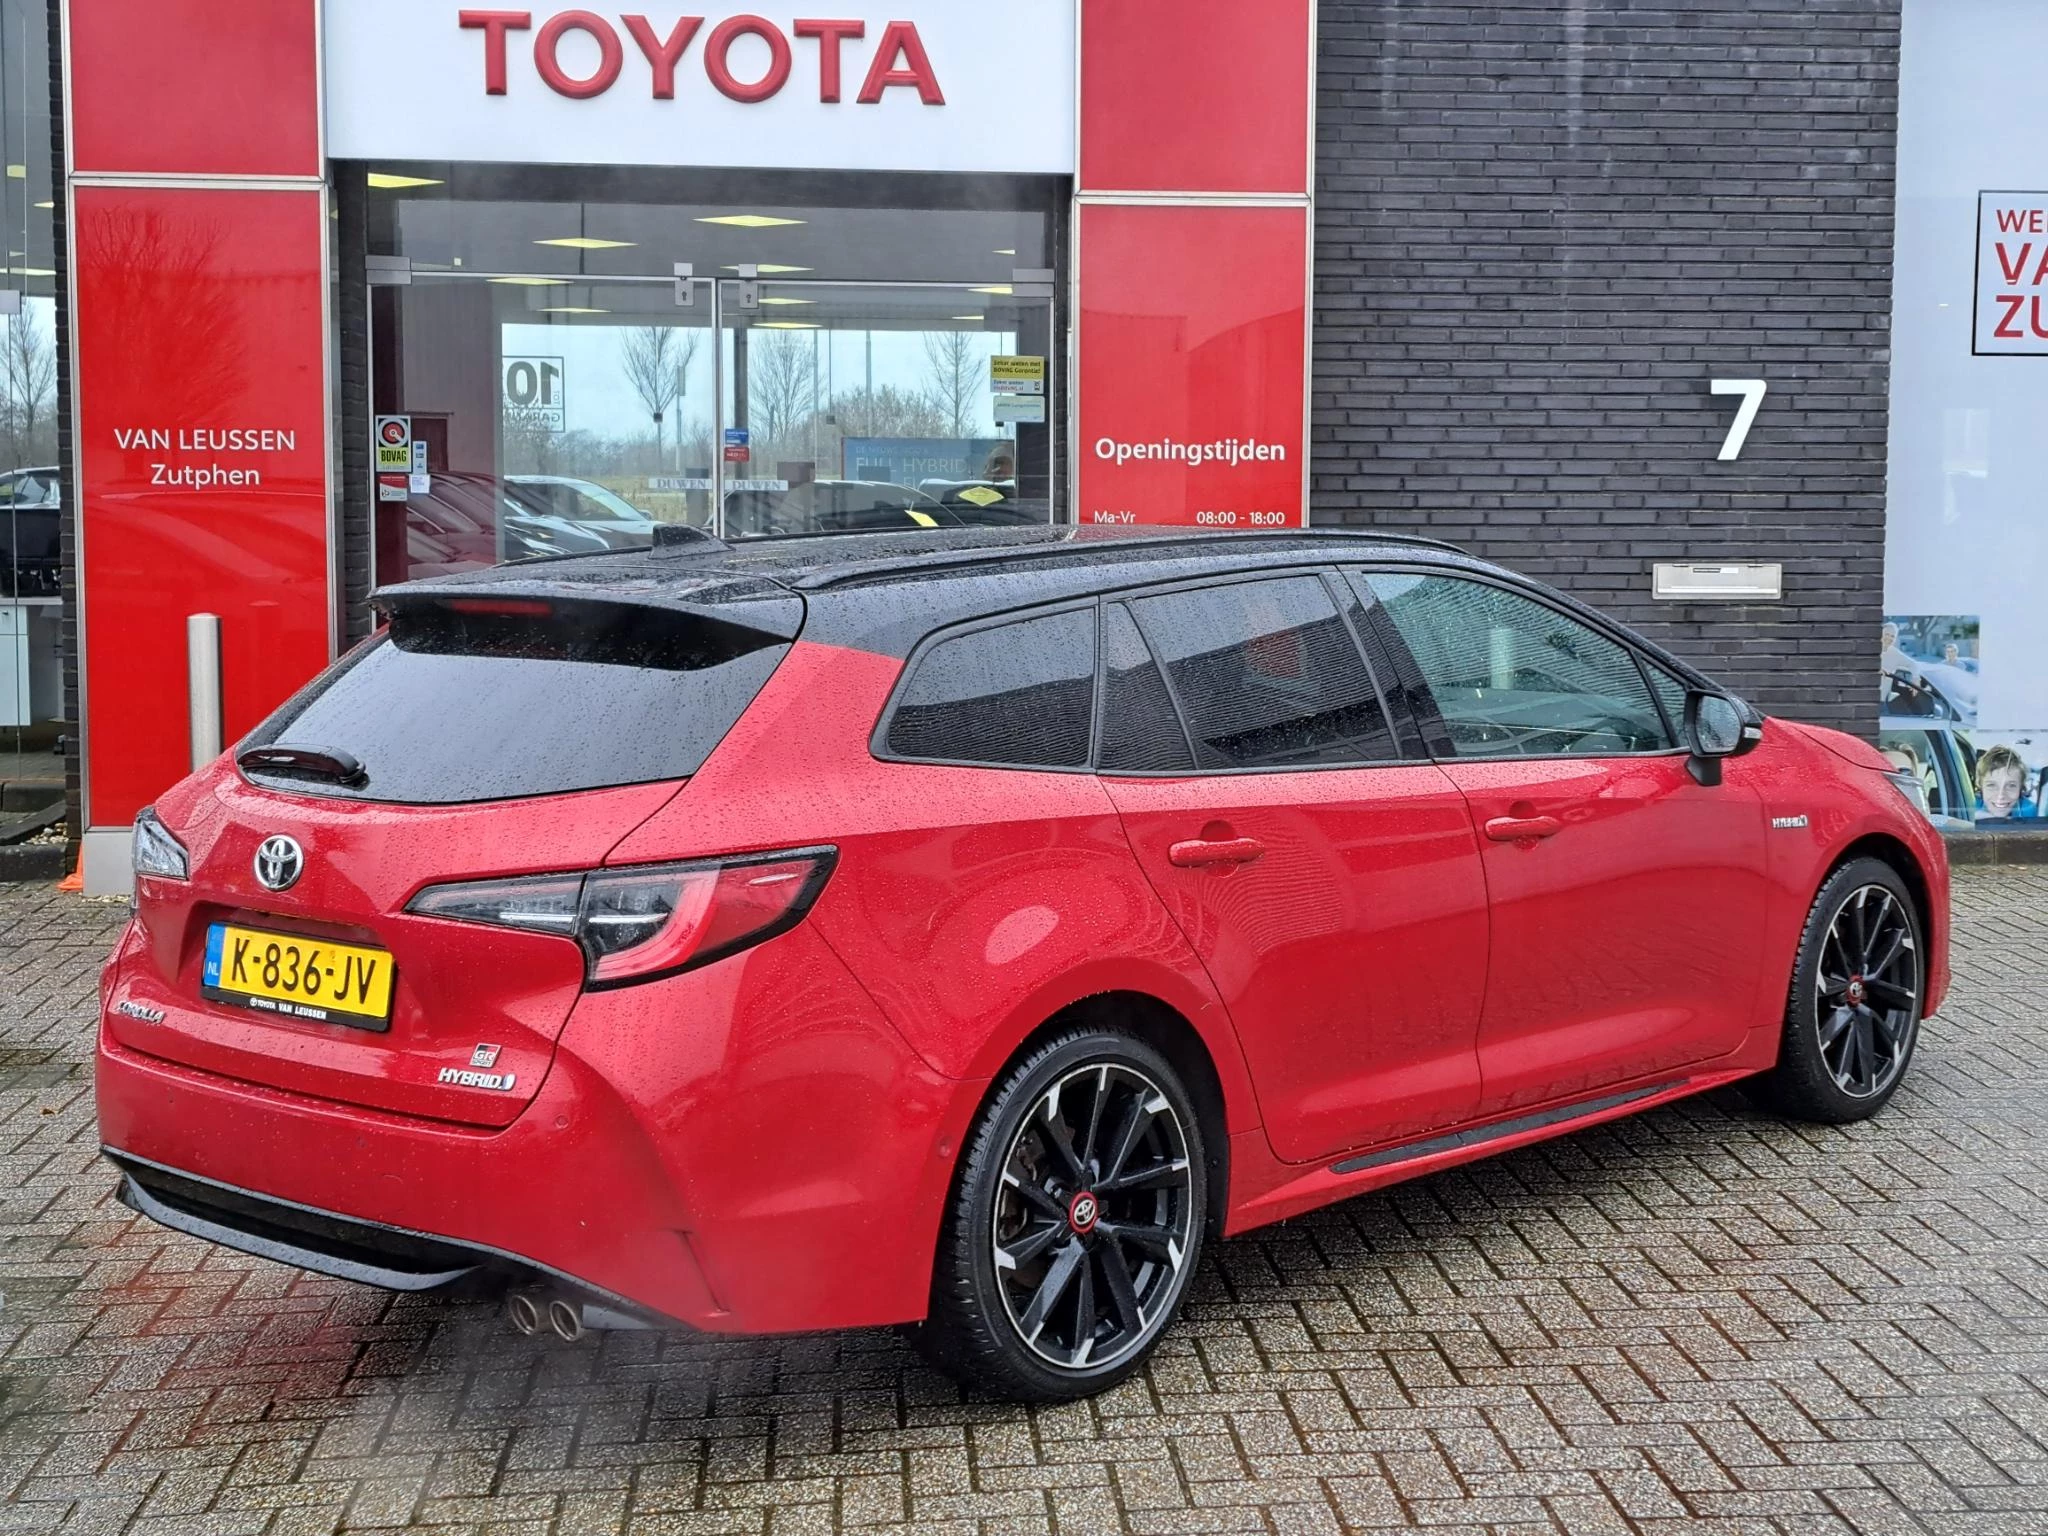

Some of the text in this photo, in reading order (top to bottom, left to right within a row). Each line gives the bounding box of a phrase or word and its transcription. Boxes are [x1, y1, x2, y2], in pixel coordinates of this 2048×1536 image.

[459, 9, 946, 105] TOYOTA
[1996, 209, 2048, 233] WE
[1710, 379, 1767, 461] 7
[114, 428, 296, 451] VAN LEUSSEN
[381, 450, 407, 462] BOVAG
[1095, 438, 1286, 467] Openingstijden
[903, 457, 965, 473] HYBRID
[151, 463, 260, 491] Zutphen
[656, 478, 706, 489] DUWEN
[732, 481, 781, 490] DUWEN
[1094, 510, 1136, 524] Ma-Vr
[1196, 511, 1236, 524] 08:00
[1250, 511, 1286, 525] 18:00
[207, 961, 219, 976] NL
[231, 937, 377, 1005] K-836-JV
[117, 1000, 166, 1024] COROLLA
[257, 999, 327, 1019] TOYOTA VAN LEUSSEN
[474, 1050, 497, 1061] GR
[438, 1067, 503, 1089] HYBRID
